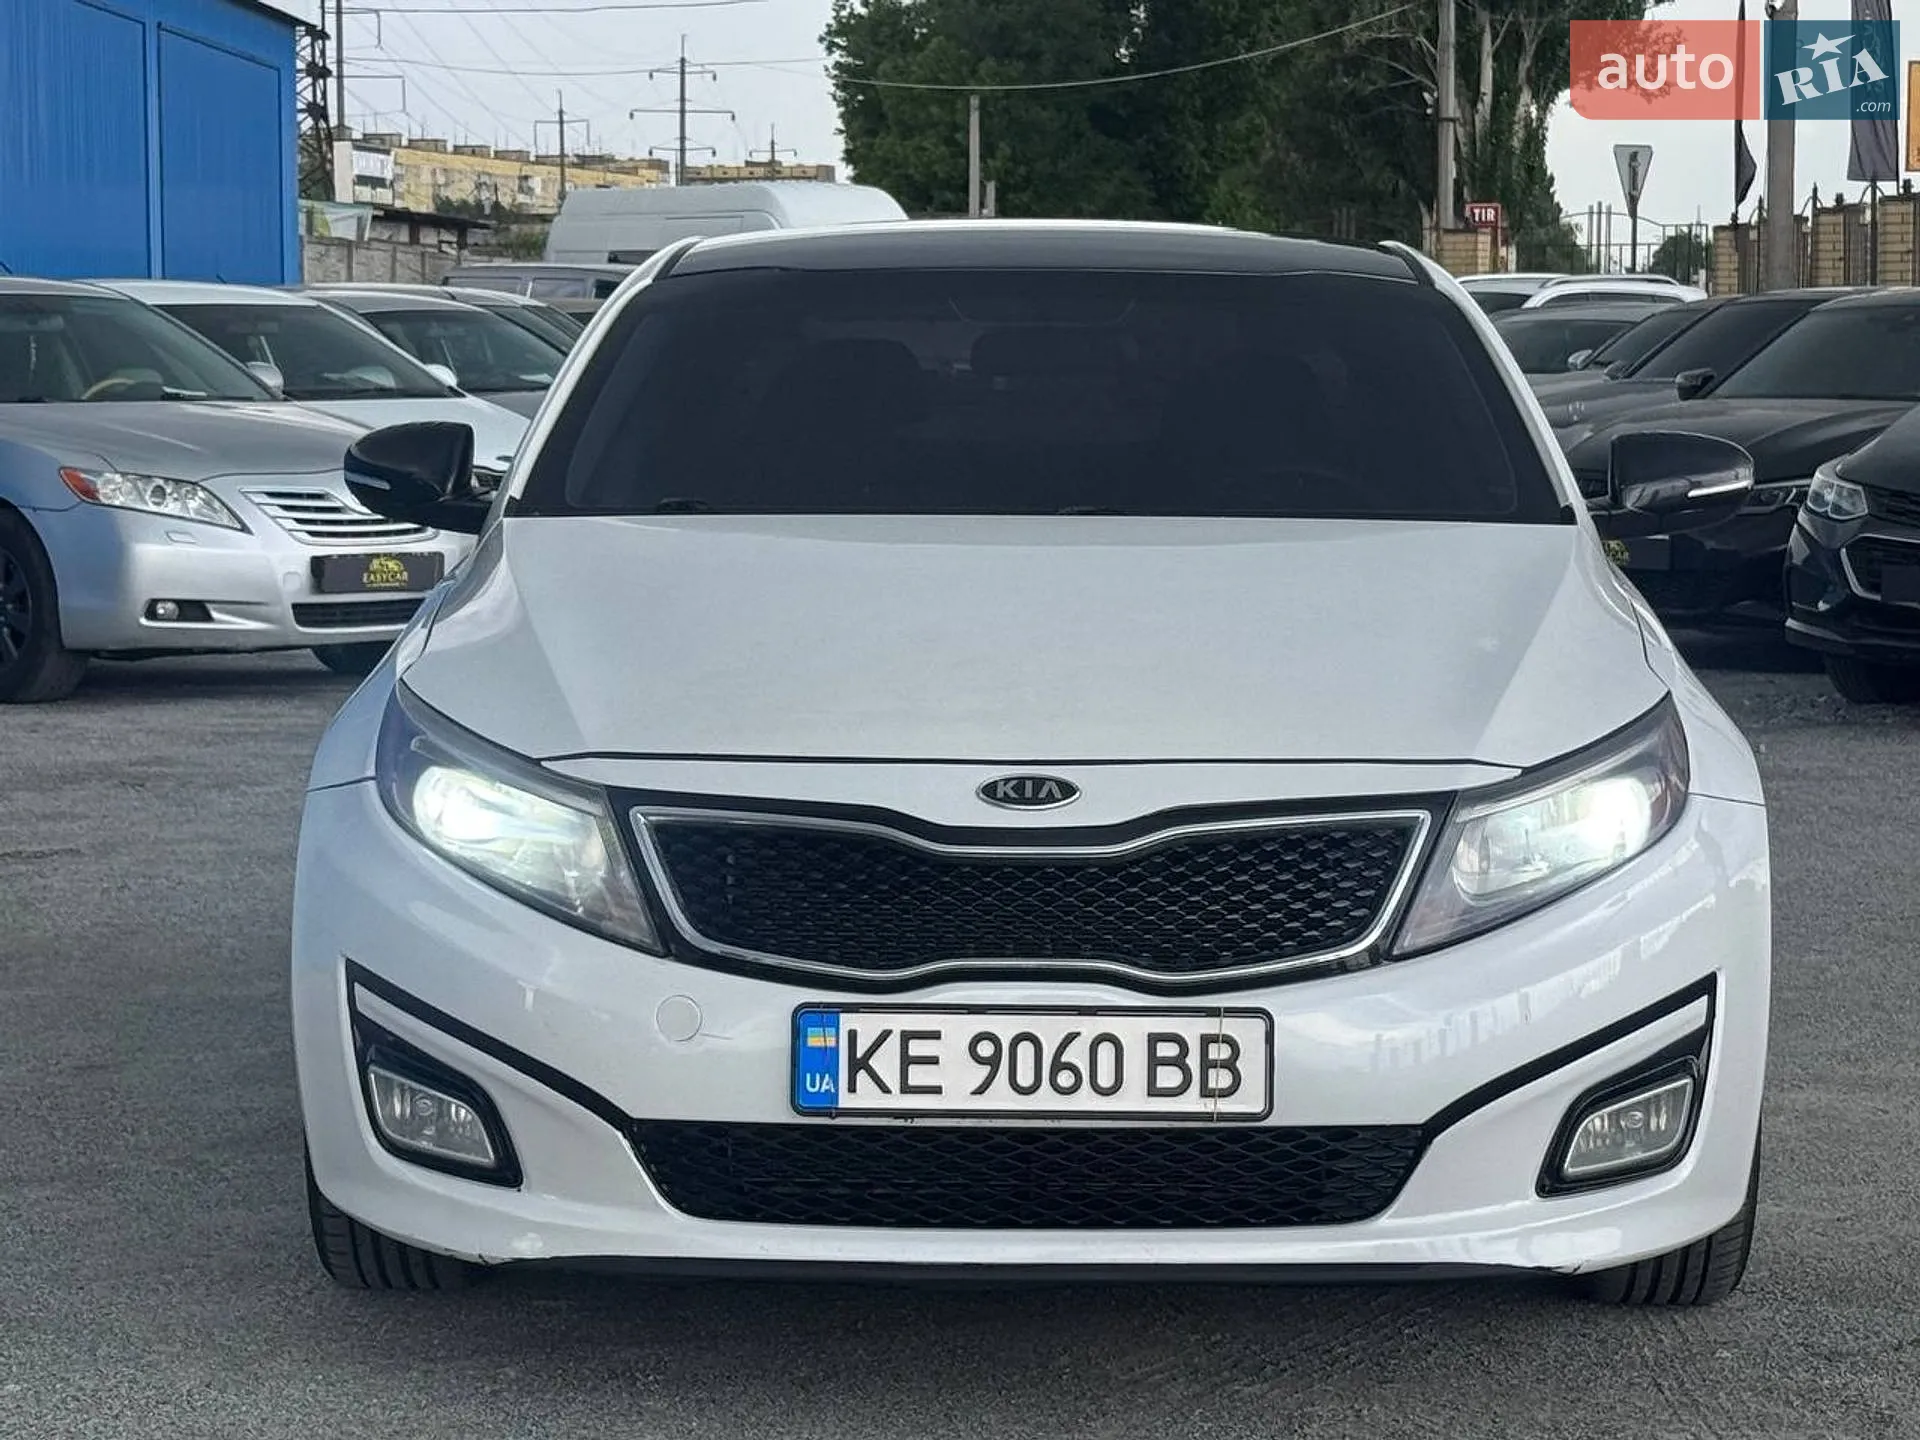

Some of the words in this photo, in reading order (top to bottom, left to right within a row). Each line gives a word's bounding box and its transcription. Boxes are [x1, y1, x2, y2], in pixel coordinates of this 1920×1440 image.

[1473, 208, 1496, 222] TIR
[996, 780, 1062, 799] KIA
[805, 1073, 835, 1093] UA
[846, 1028, 943, 1096] KE
[968, 1031, 1124, 1097] 9060
[1147, 1032, 1242, 1098] BB
